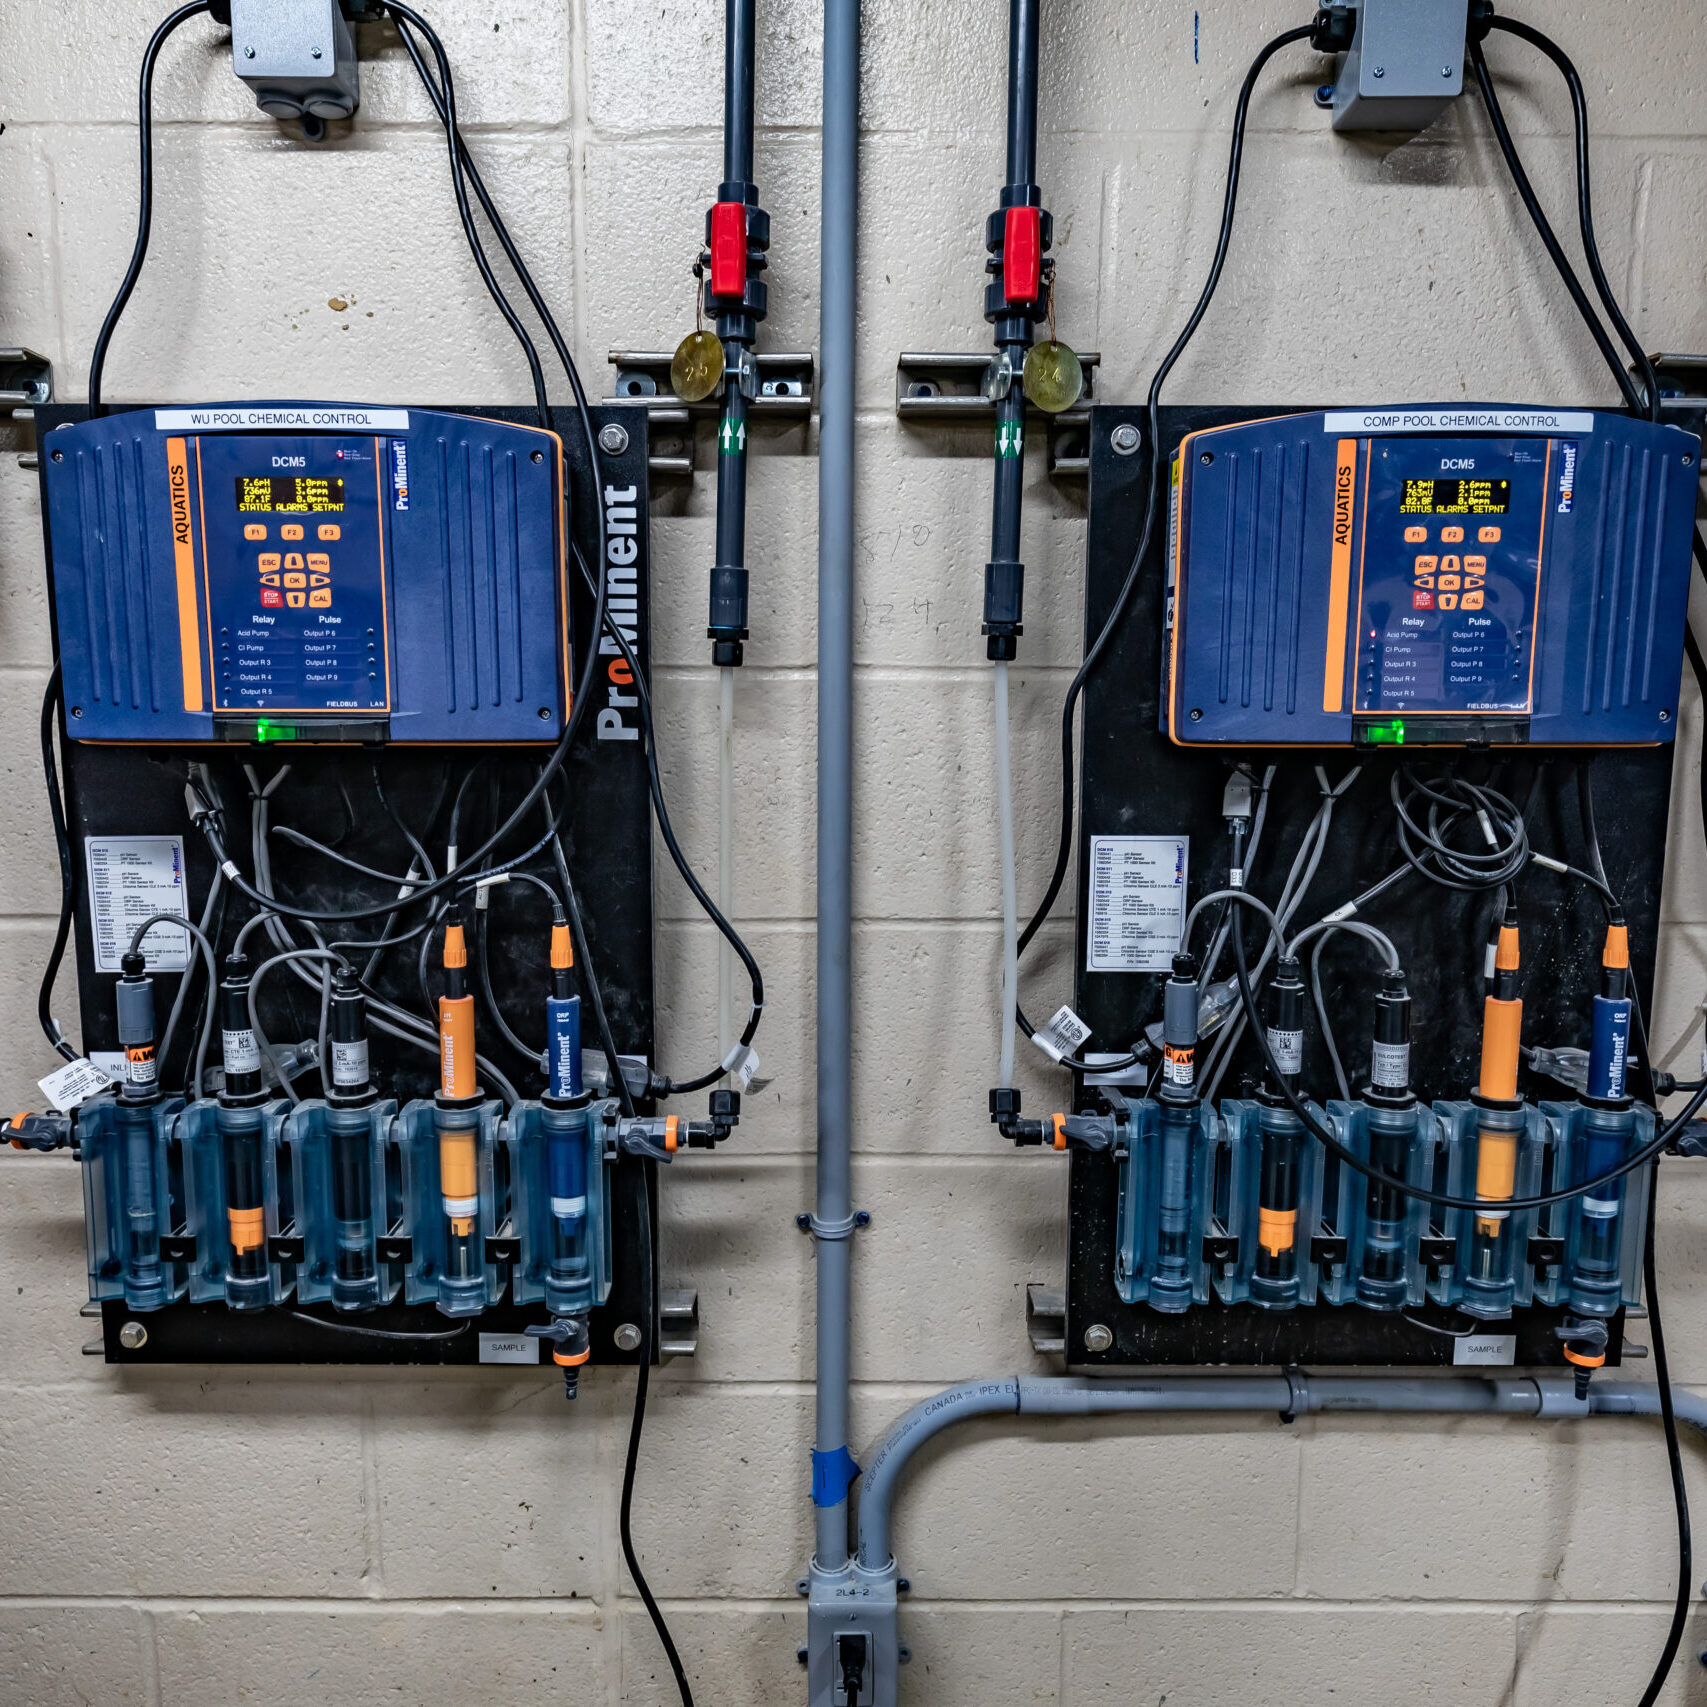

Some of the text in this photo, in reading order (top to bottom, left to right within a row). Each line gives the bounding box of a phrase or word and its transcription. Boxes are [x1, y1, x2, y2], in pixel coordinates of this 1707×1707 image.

[191, 414, 372, 424] WU POOL CHEMICAL CONTROL
[1363, 416, 1559, 427] COMP POOL CHEMICAL CONTROL
[272, 457, 305, 467] DCM5
[1440, 459, 1475, 470] DCM5
[395, 444, 409, 510] ProMinent
[1558, 448, 1576, 513] ProMinent
[243, 479, 328, 487] 7.6pH 5.0ppm
[296, 487, 328, 495] 3.6ppm
[1406, 489, 1490, 497] 763mV 2.1ppm
[171, 465, 189, 544] AQUATICS
[239, 503, 344, 512] STATUS ALARMS SETPNT
[1335, 466, 1351, 545] AQUATICS
[1400, 505, 1505, 513] STATUS ALARMS SETPNT
[597, 484, 639, 740] ProMinent
[253, 616, 275, 624] Relay
[319, 616, 341, 624] Pulse
[1402, 618, 1425, 627] Relay
[1468, 618, 1491, 626] Pulse
[252, 630, 269, 638] Pump
[1401, 632, 1418, 640] Pump
[247, 645, 264, 653] Pump
[1394, 646, 1411, 654] Pump
[1452, 646, 1472, 654] Output
[239, 659, 259, 667] Output
[305, 659, 325, 667] Output
[1450, 675, 1470, 683] Output
[241, 688, 260, 696] Output
[1383, 690, 1403, 698] Output
[173, 847, 181, 884] ProMinent
[1175, 847, 1184, 884] ProMinent
[443, 1034, 455, 1097] ProMinent
[557, 1034, 572, 1097] ProMinent
[1607, 1036, 1625, 1098] ProMinent
[491, 1343, 527, 1352] SAMPLE
[1467, 1345, 1503, 1353] SAMPLE
[924, 1392, 963, 1417] CANADA
[979, 1385, 1000, 1395] IPEX
[835, 1588, 870, 1597] 2L4-2
